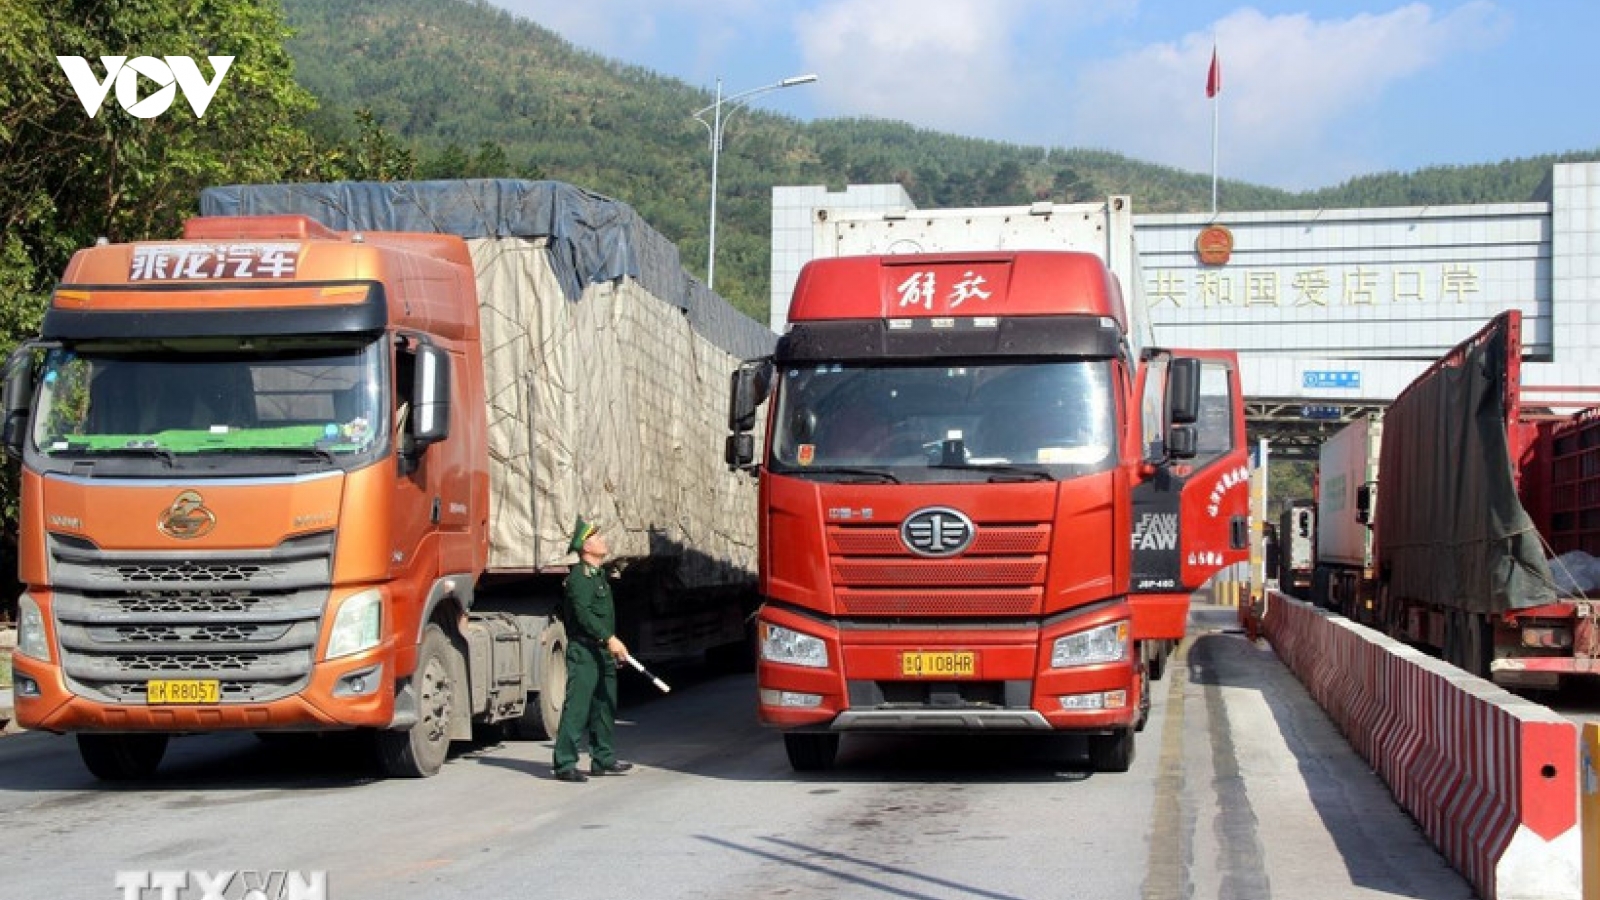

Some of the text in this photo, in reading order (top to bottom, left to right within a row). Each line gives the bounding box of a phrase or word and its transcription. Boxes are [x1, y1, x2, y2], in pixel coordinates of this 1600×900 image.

[130, 243, 300, 280] 乘龙汽车
[1146, 264, 1480, 309] 共和国爱店口岸
[1131, 533, 1178, 550] FAW
